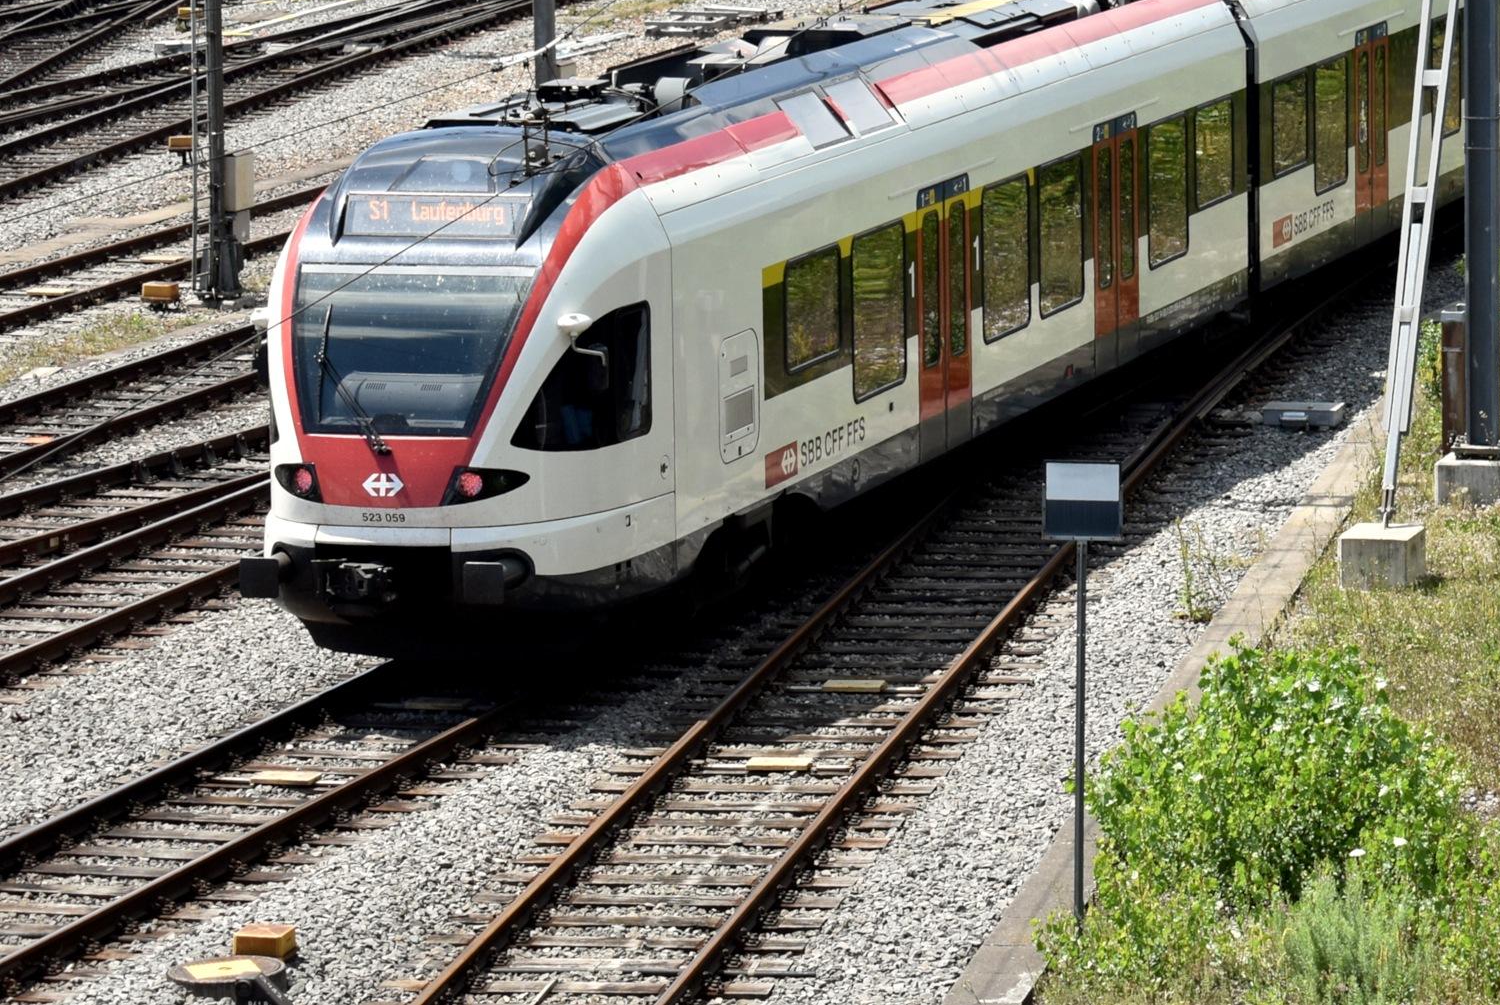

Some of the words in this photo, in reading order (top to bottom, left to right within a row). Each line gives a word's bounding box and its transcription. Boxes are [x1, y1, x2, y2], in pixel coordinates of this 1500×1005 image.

[369, 199, 389, 221] S1
[411, 199, 505, 226] Laufenburg
[1294, 211, 1308, 236] SBB
[1309, 205, 1321, 229] CFF
[1322, 199, 1335, 222] FFS
[973, 235, 980, 271] 1
[908, 261, 916, 298] 1
[801, 435, 823, 467] SBB
[824, 426, 844, 457] CFF
[847, 416, 866, 447] FFS
[362, 512, 383, 523] 523
[385, 512, 406, 523] 059
